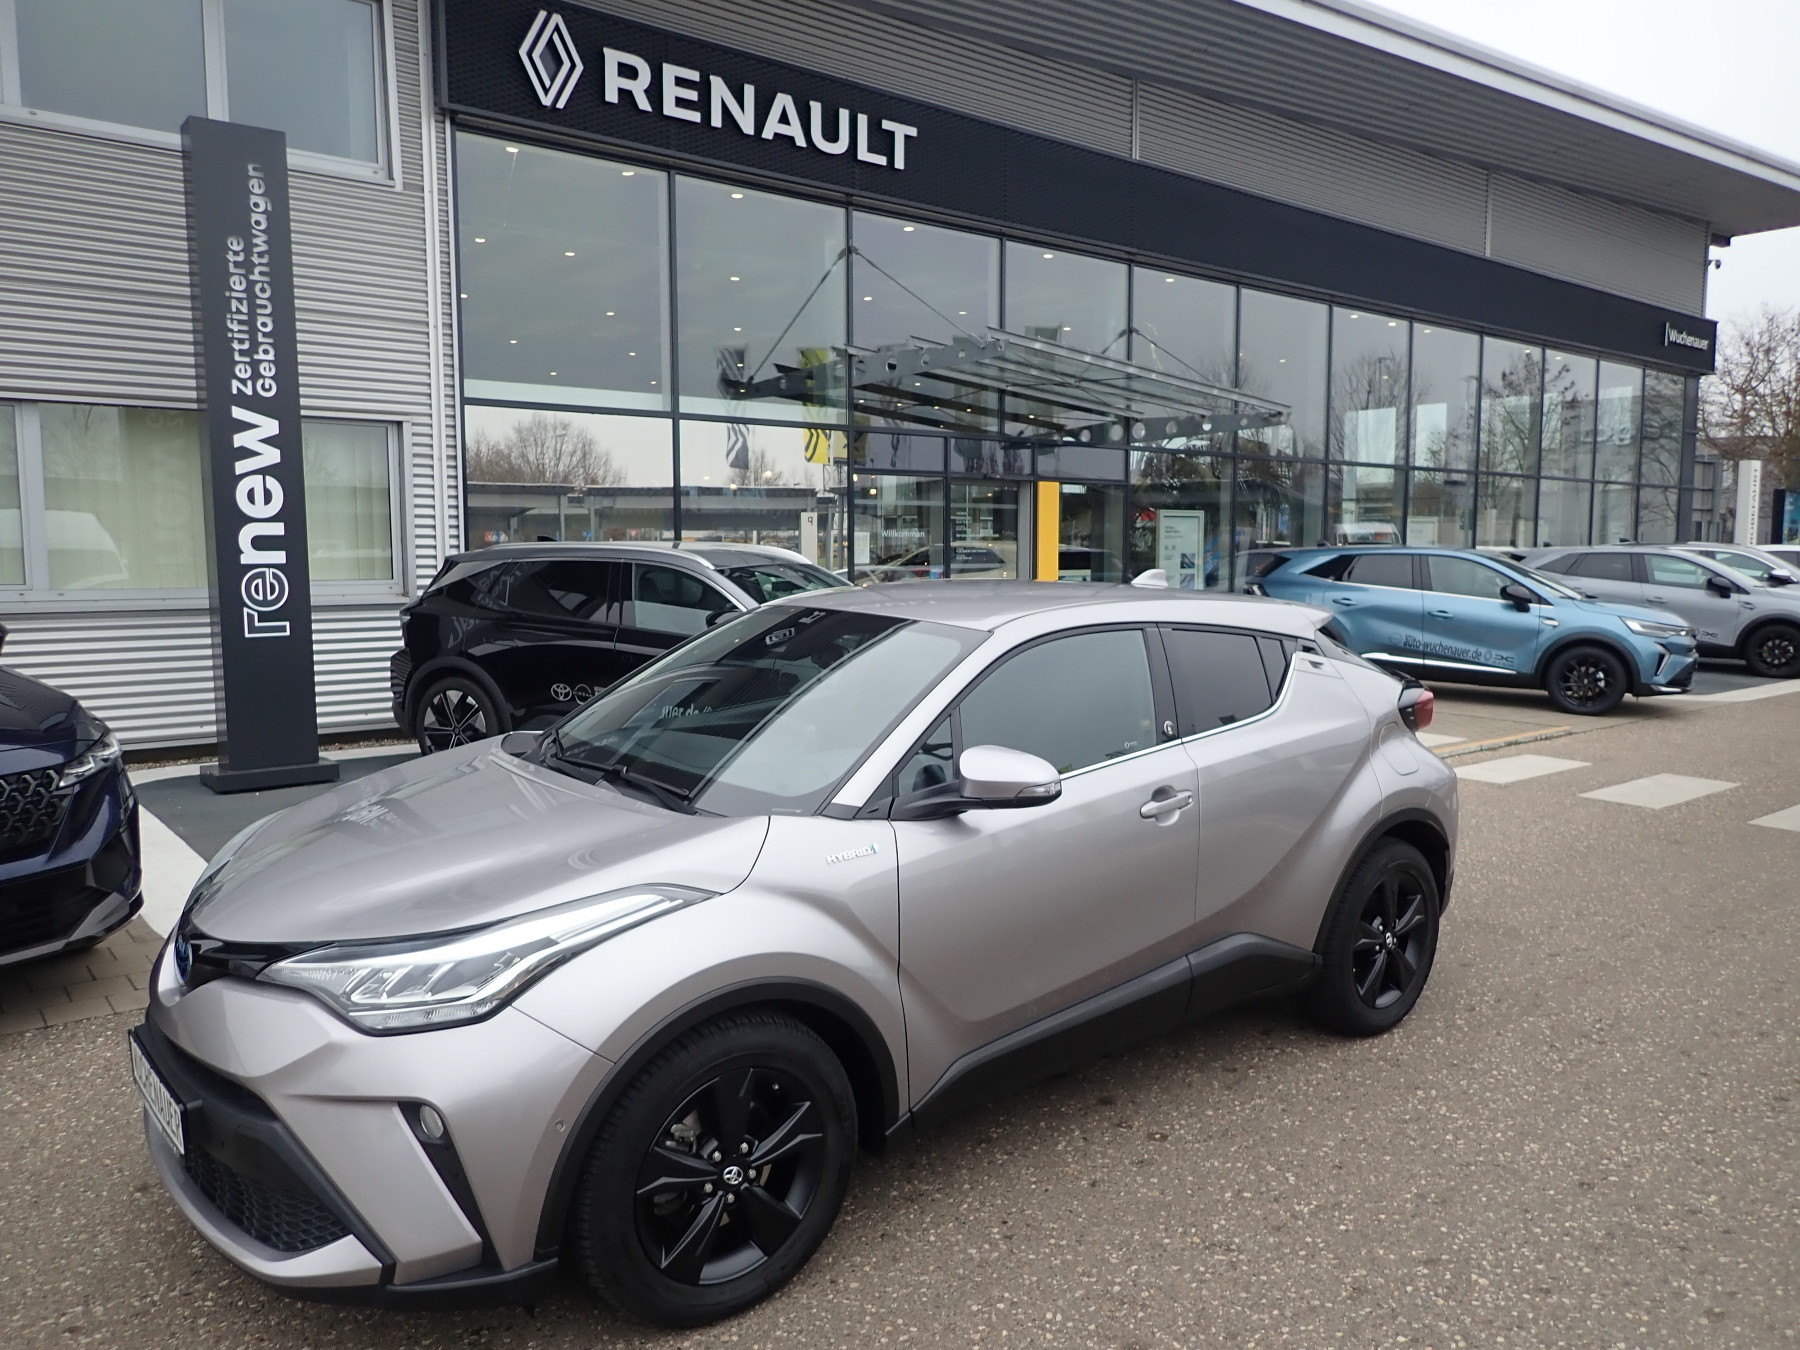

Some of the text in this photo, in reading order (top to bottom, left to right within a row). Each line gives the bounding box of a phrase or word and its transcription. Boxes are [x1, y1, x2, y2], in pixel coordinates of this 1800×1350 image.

[603, 47, 918, 170] RENAULT
[225, 236, 252, 396] Zertifizierte
[247, 162, 277, 398] Gebrauchtwagen
[1669, 328, 1709, 350] Wuchenauer
[231, 405, 291, 638] renew
[881, 529, 925, 538] Willkommen
[1402, 636, 1482, 660] auto-wuchenauer.de
[825, 846, 872, 865] HYBRID
